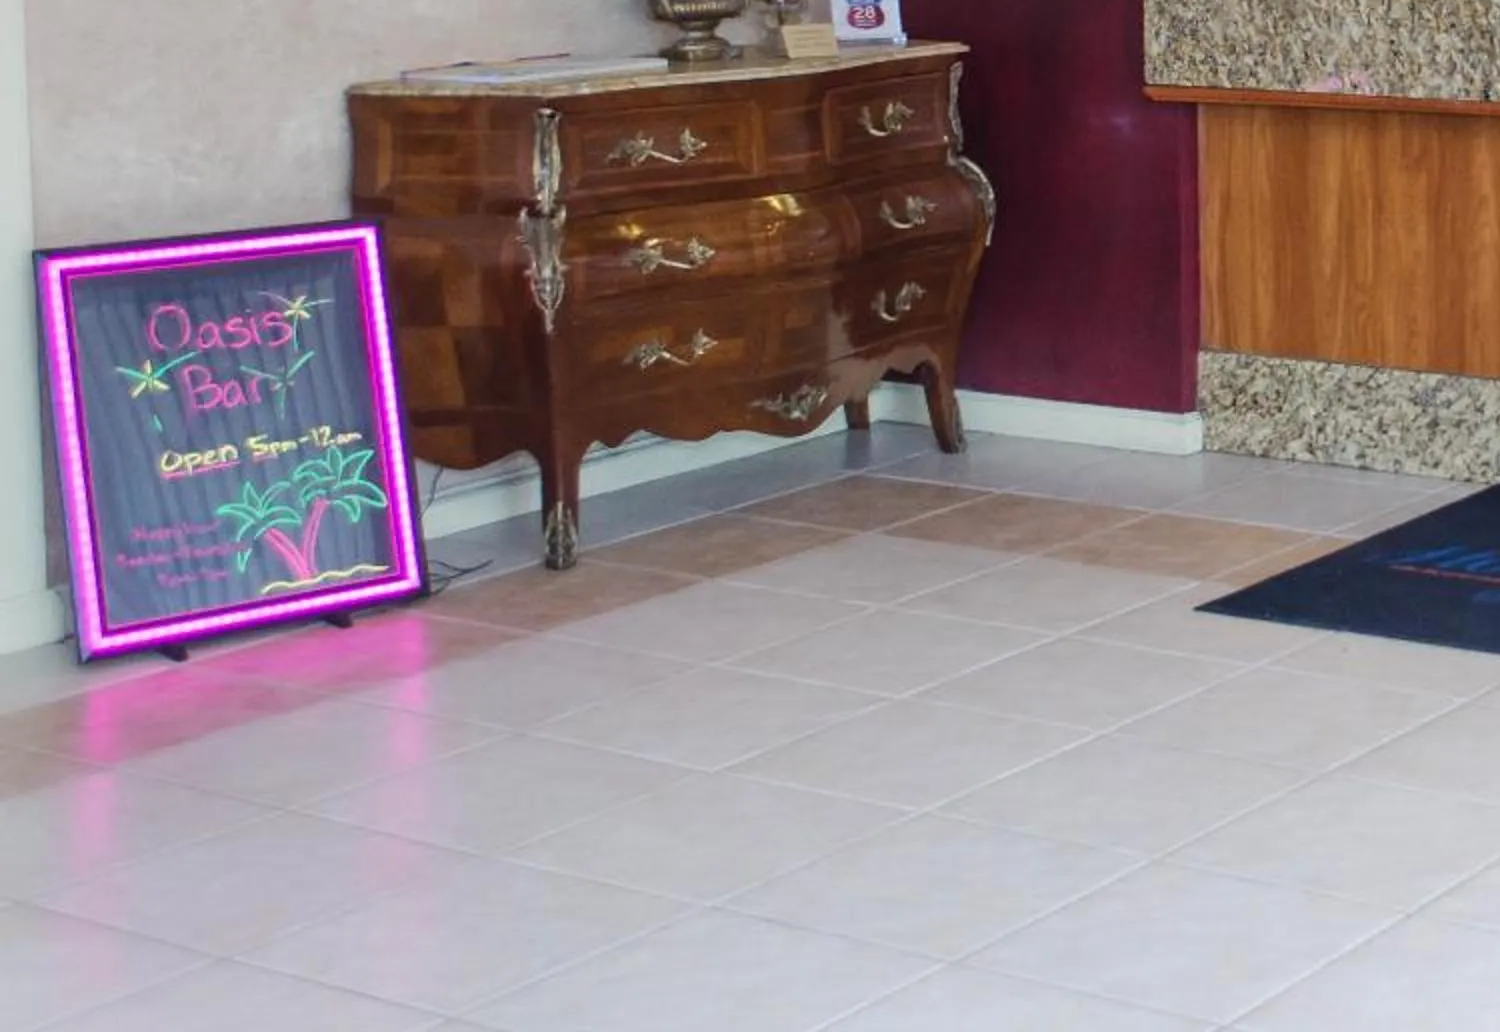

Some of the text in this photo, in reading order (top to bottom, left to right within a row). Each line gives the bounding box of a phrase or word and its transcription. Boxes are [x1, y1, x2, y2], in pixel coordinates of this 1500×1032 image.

[148, 304, 293, 351] Oasis
[180, 364, 264, 410] Bar
[160, 444, 239, 475] Open
